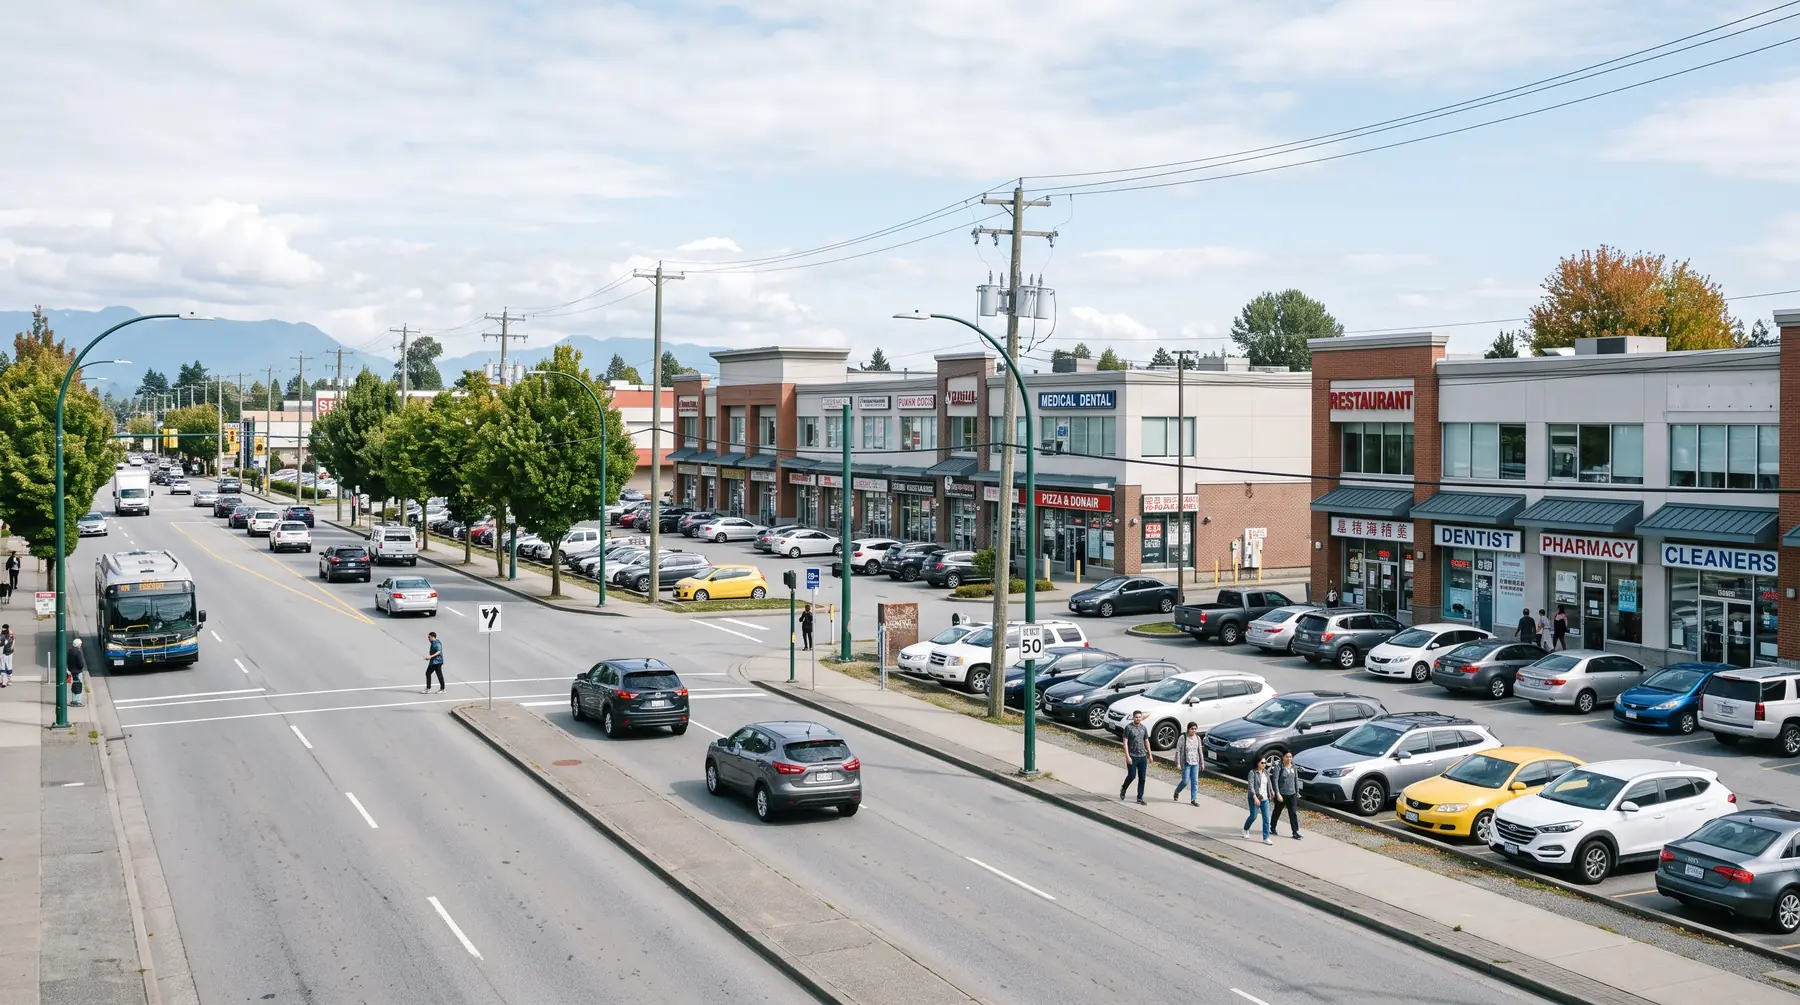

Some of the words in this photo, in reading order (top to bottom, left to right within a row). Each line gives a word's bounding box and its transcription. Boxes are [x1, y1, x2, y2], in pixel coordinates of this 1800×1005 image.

[1041, 394, 1076, 407] MEDICAL
[1080, 393, 1111, 407] DENTAL
[1329, 390, 1413, 410] RESTAURANT
[1042, 493, 1062, 505] PIZZA
[1063, 496, 1069, 506] &
[1070, 496, 1099, 508] DONAIR
[1442, 527, 1514, 548] DENTIST
[1542, 536, 1635, 559] PHARMACY
[1665, 546, 1776, 573] CLEANERS
[1022, 639, 1041, 653] 50
